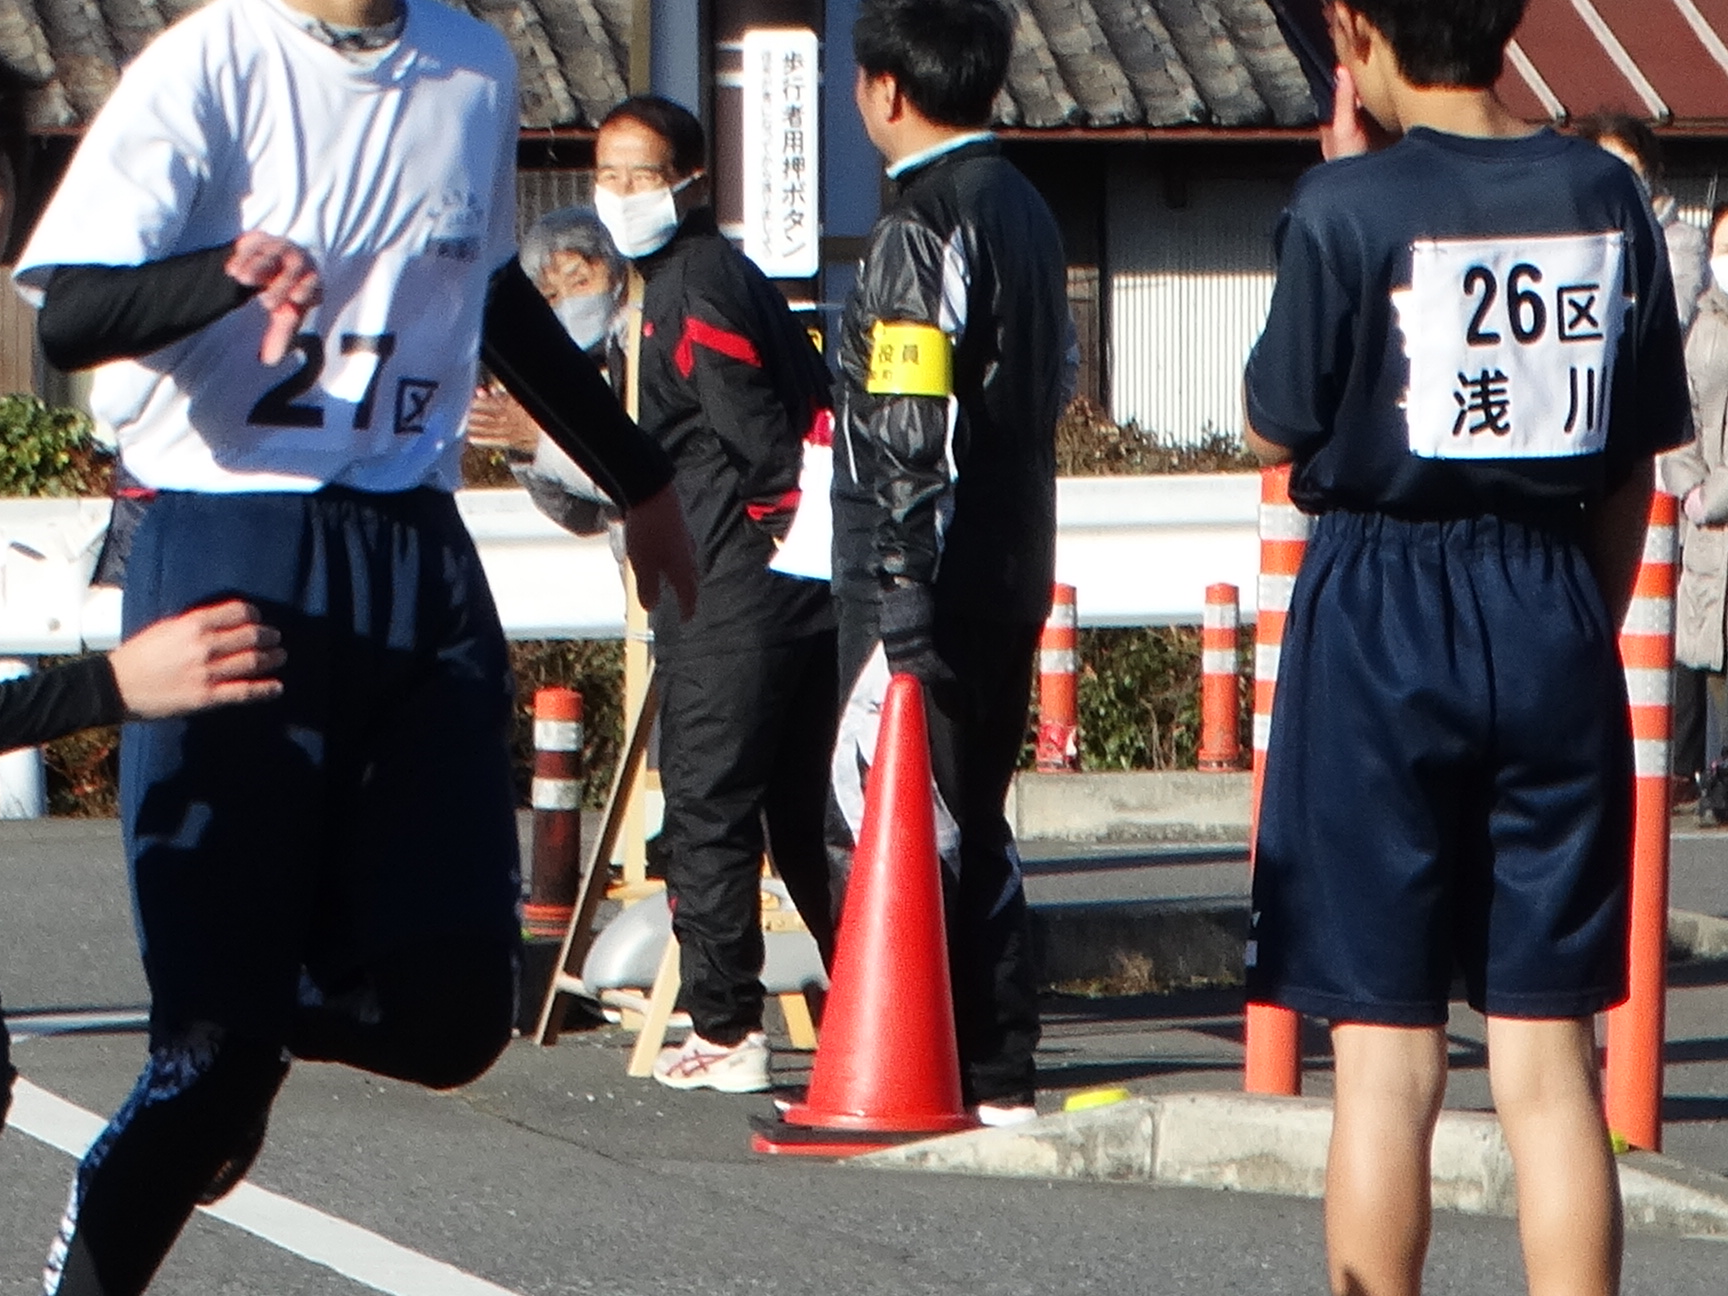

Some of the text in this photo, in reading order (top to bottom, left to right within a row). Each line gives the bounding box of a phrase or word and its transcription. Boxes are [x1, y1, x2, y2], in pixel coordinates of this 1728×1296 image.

[782, 51, 806, 258] 歩行者用押ボタン
[1462, 263, 1604, 347] 26区
[1452, 367, 1609, 437] 浅川
